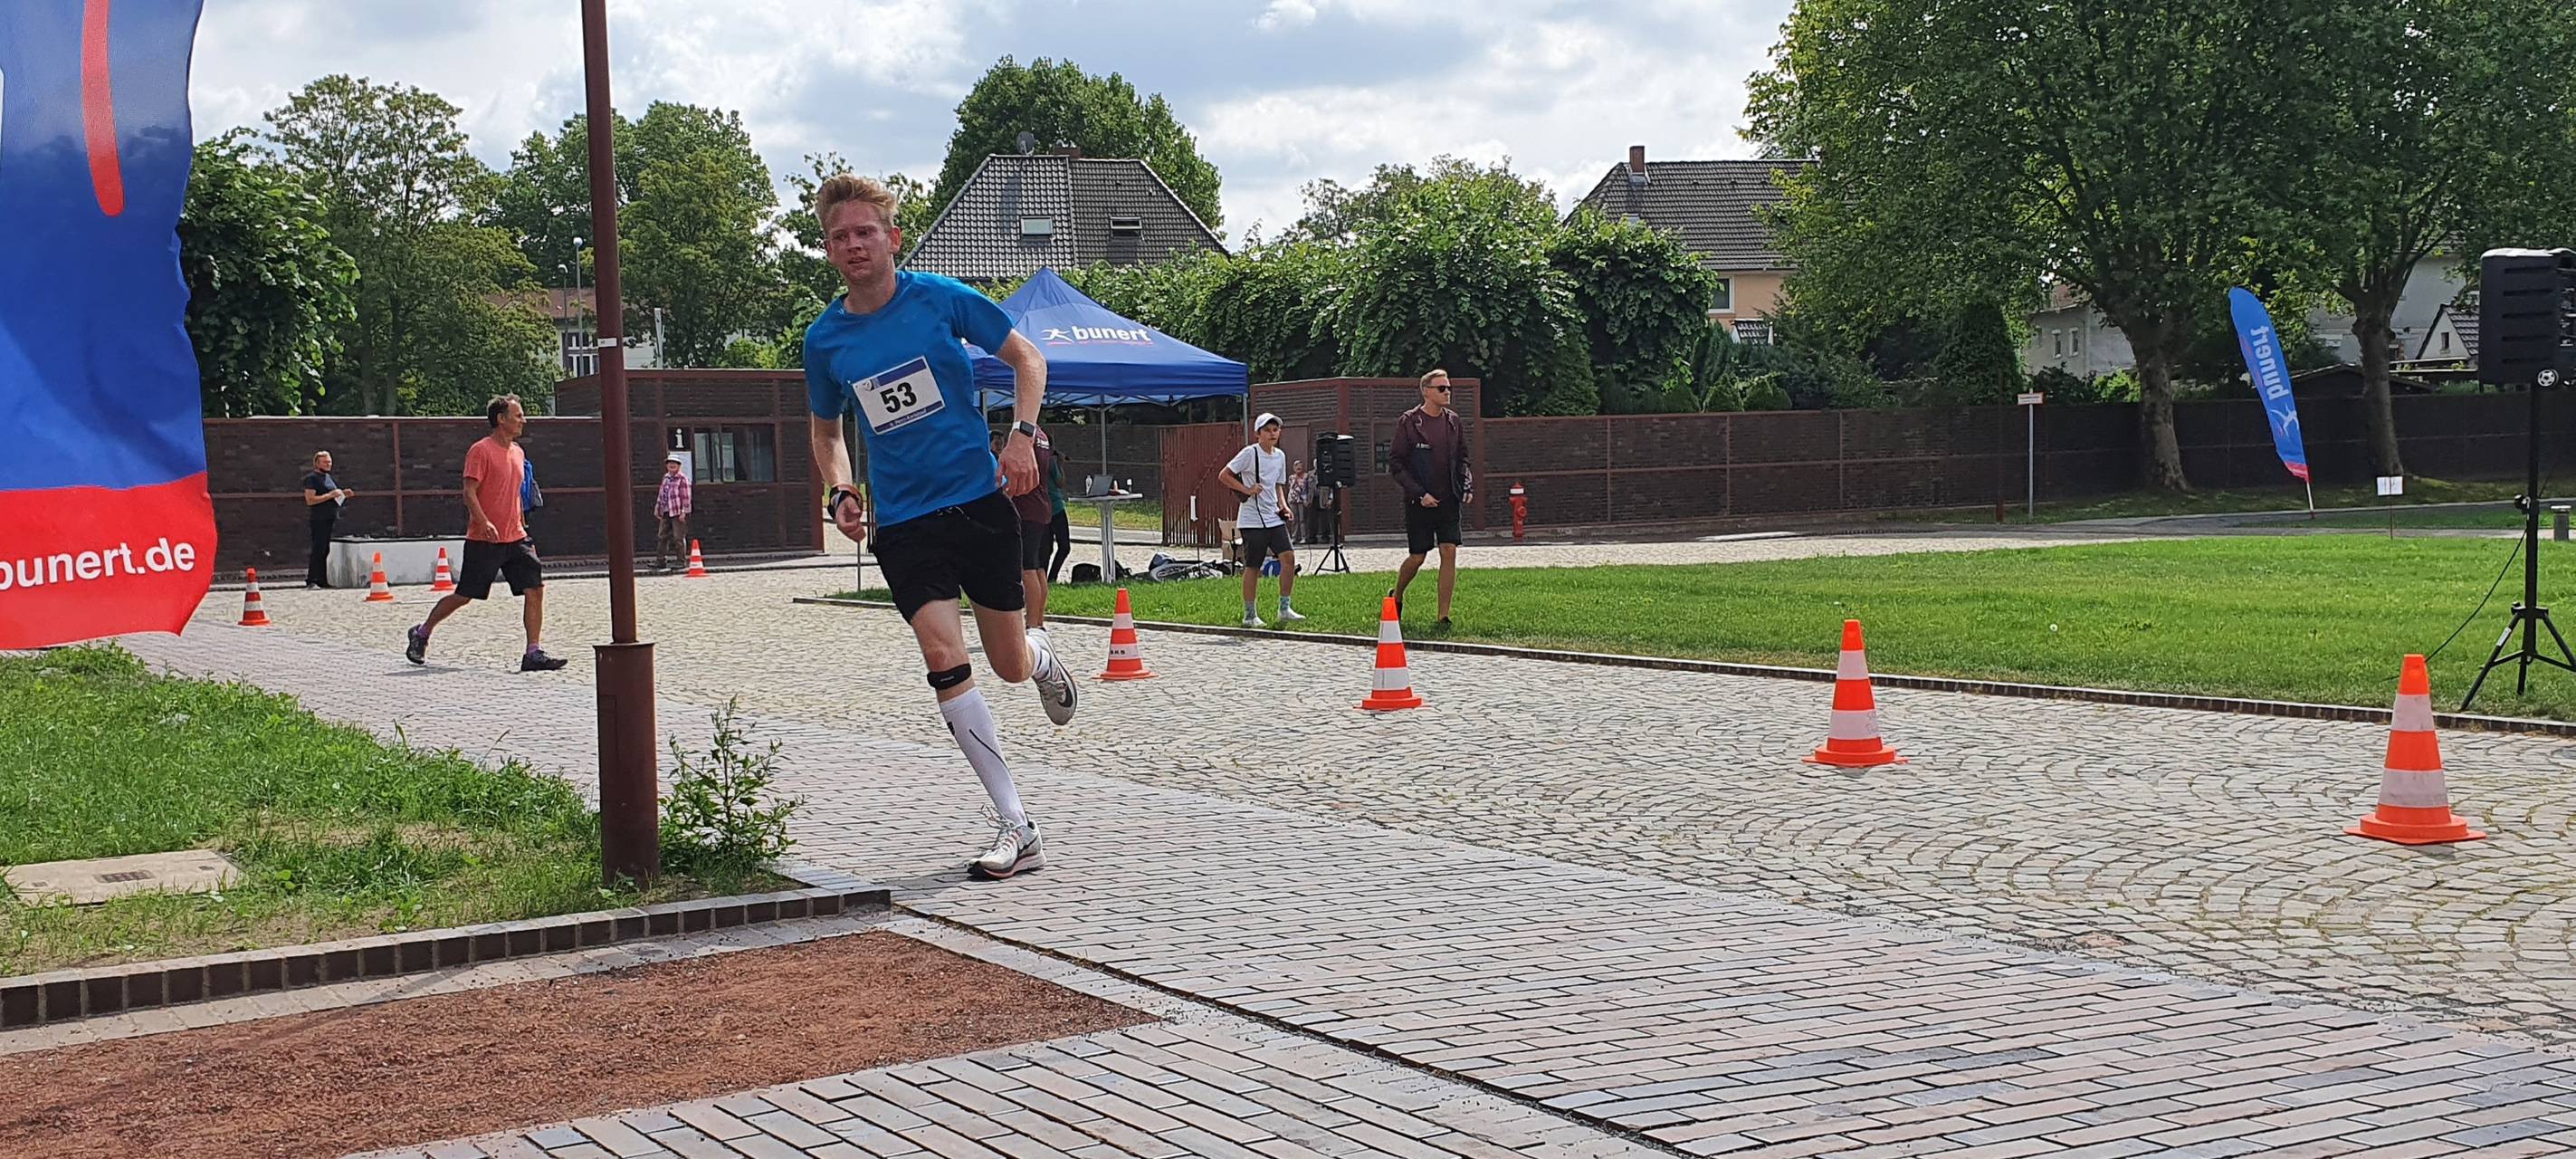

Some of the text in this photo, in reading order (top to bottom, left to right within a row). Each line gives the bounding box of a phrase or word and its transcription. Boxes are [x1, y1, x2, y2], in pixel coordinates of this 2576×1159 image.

[1072, 326, 1152, 341] bunert
[880, 382, 917, 413] 53
[675, 428, 684, 448] i
